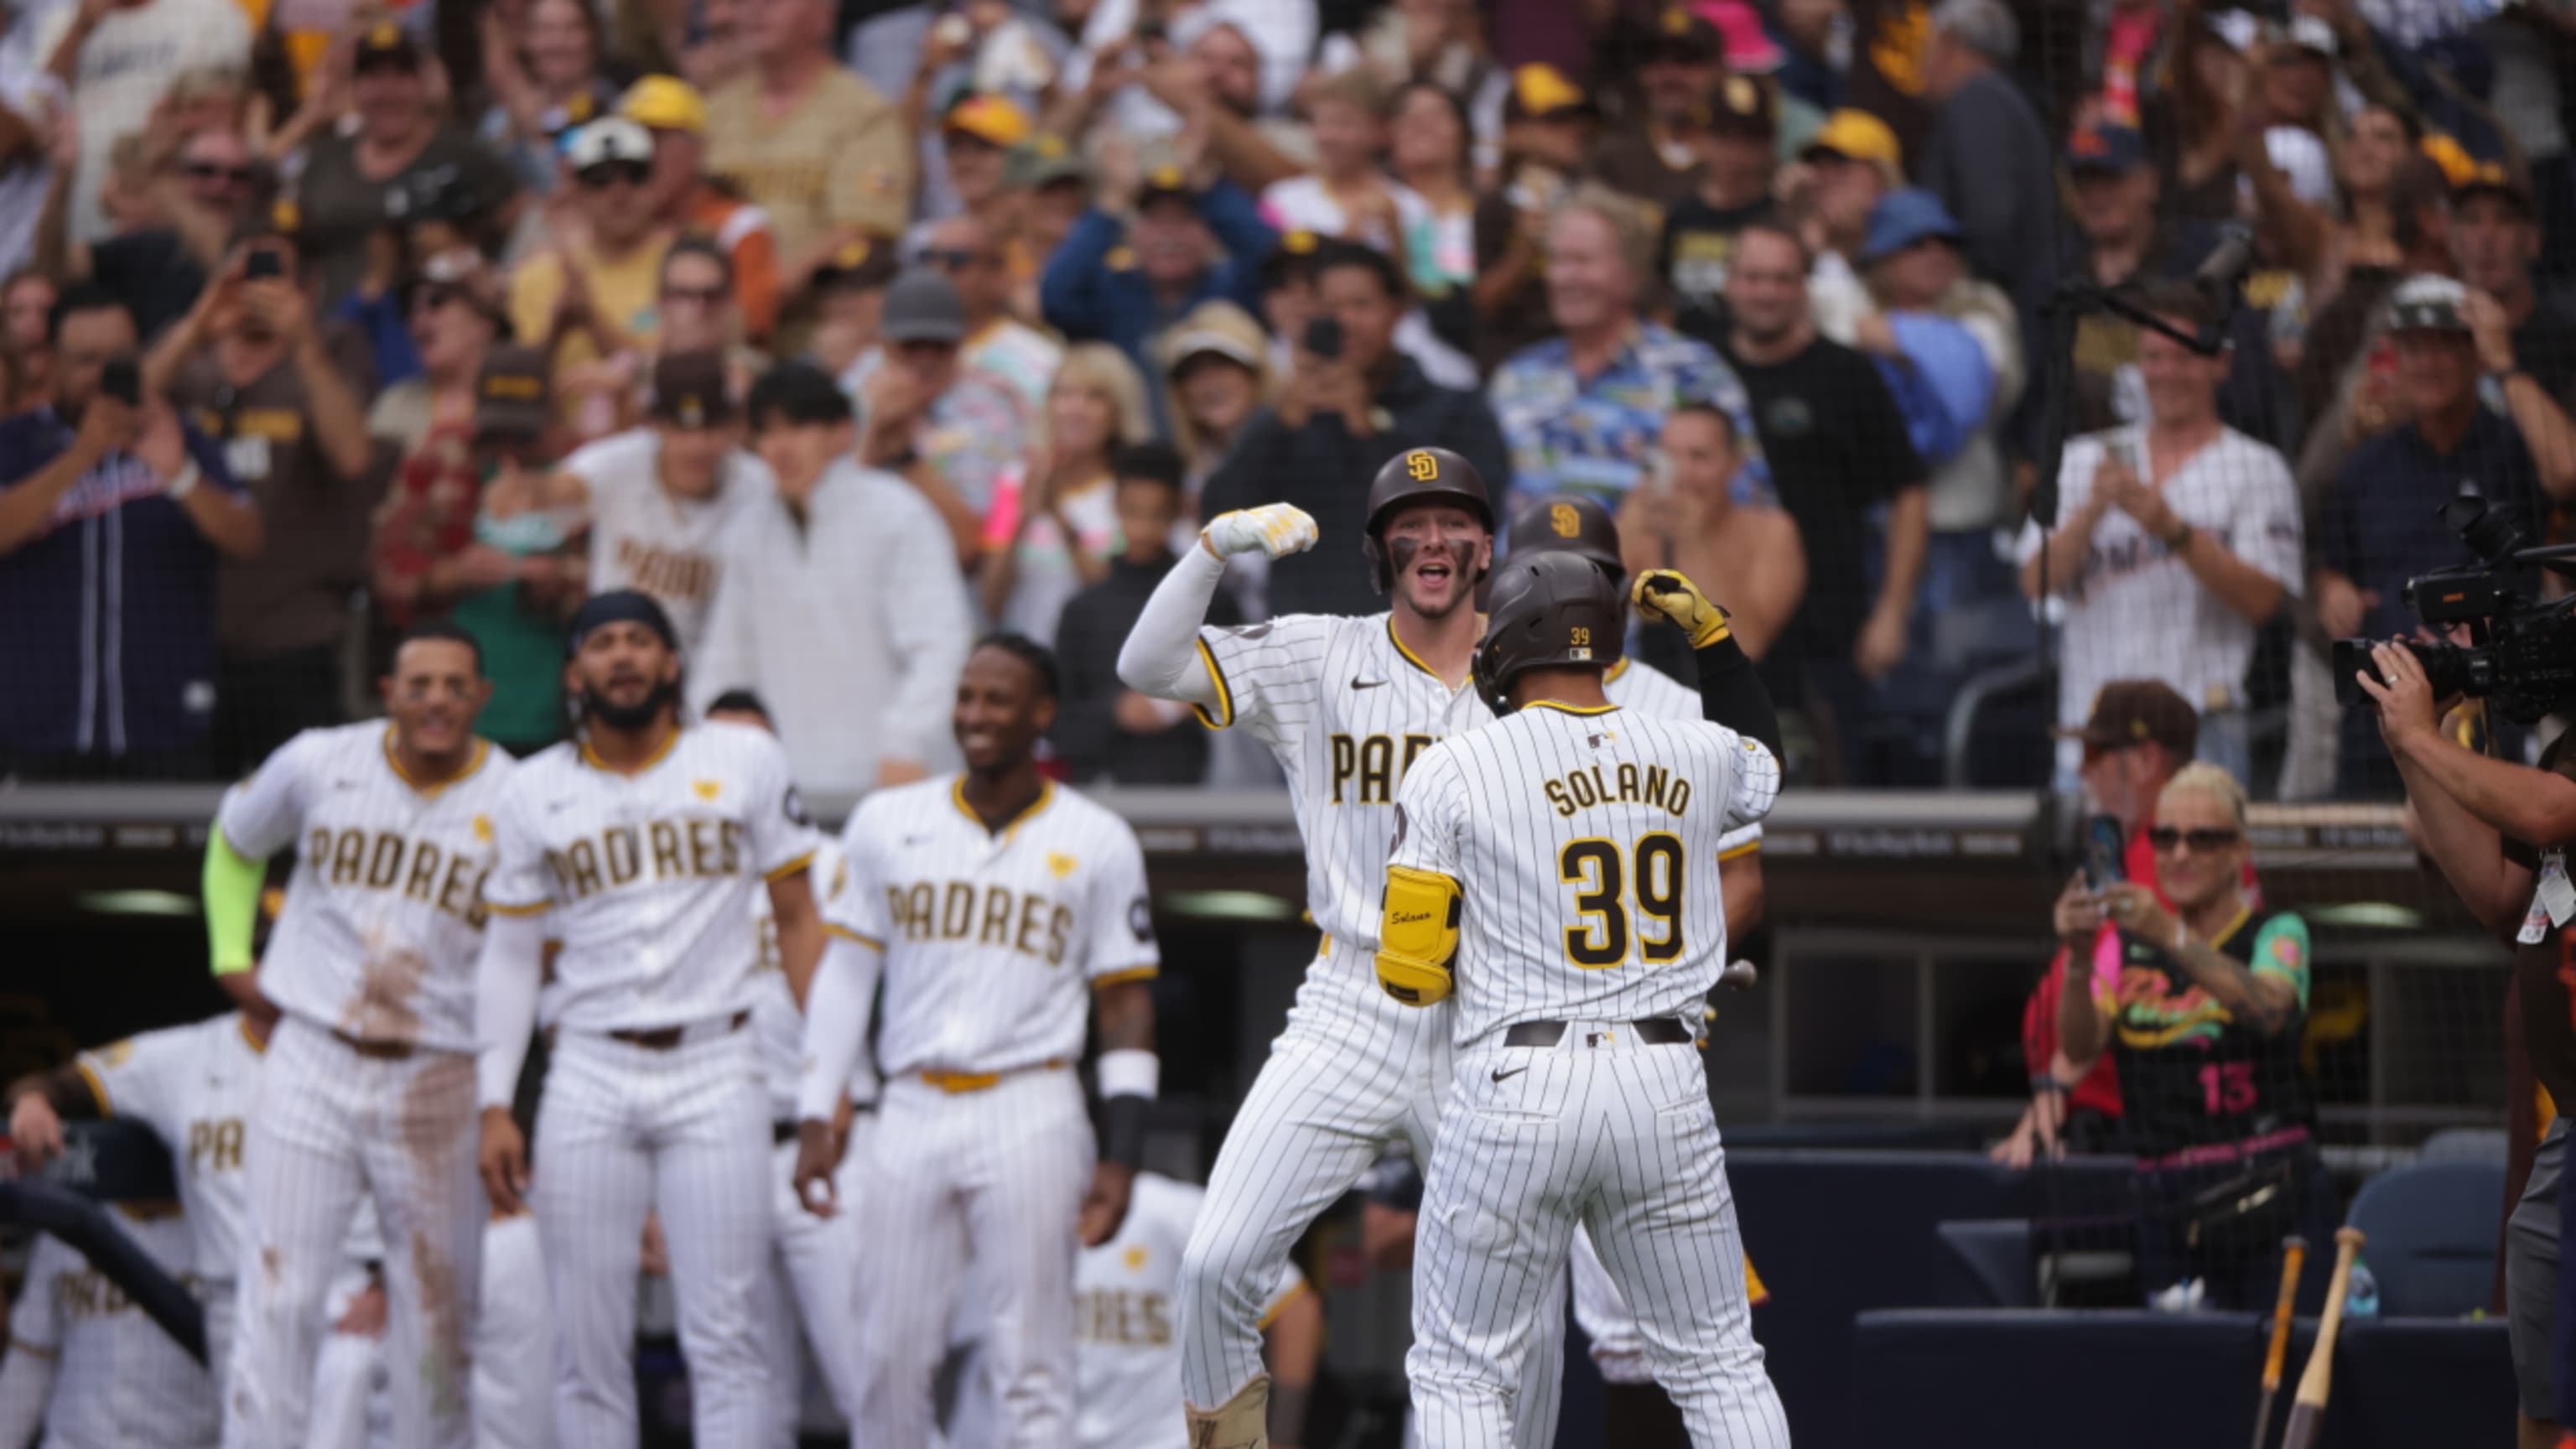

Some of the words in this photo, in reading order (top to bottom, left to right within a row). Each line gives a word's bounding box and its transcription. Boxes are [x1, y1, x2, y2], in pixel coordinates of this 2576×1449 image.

[1570, 626, 1591, 646] 39
[1544, 762, 1690, 818] SOLANO
[886, 880, 1073, 968] PADRES
[1391, 911, 1432, 925] Solano
[1557, 829, 1686, 970] 39
[2198, 1062, 2258, 1114] 13
